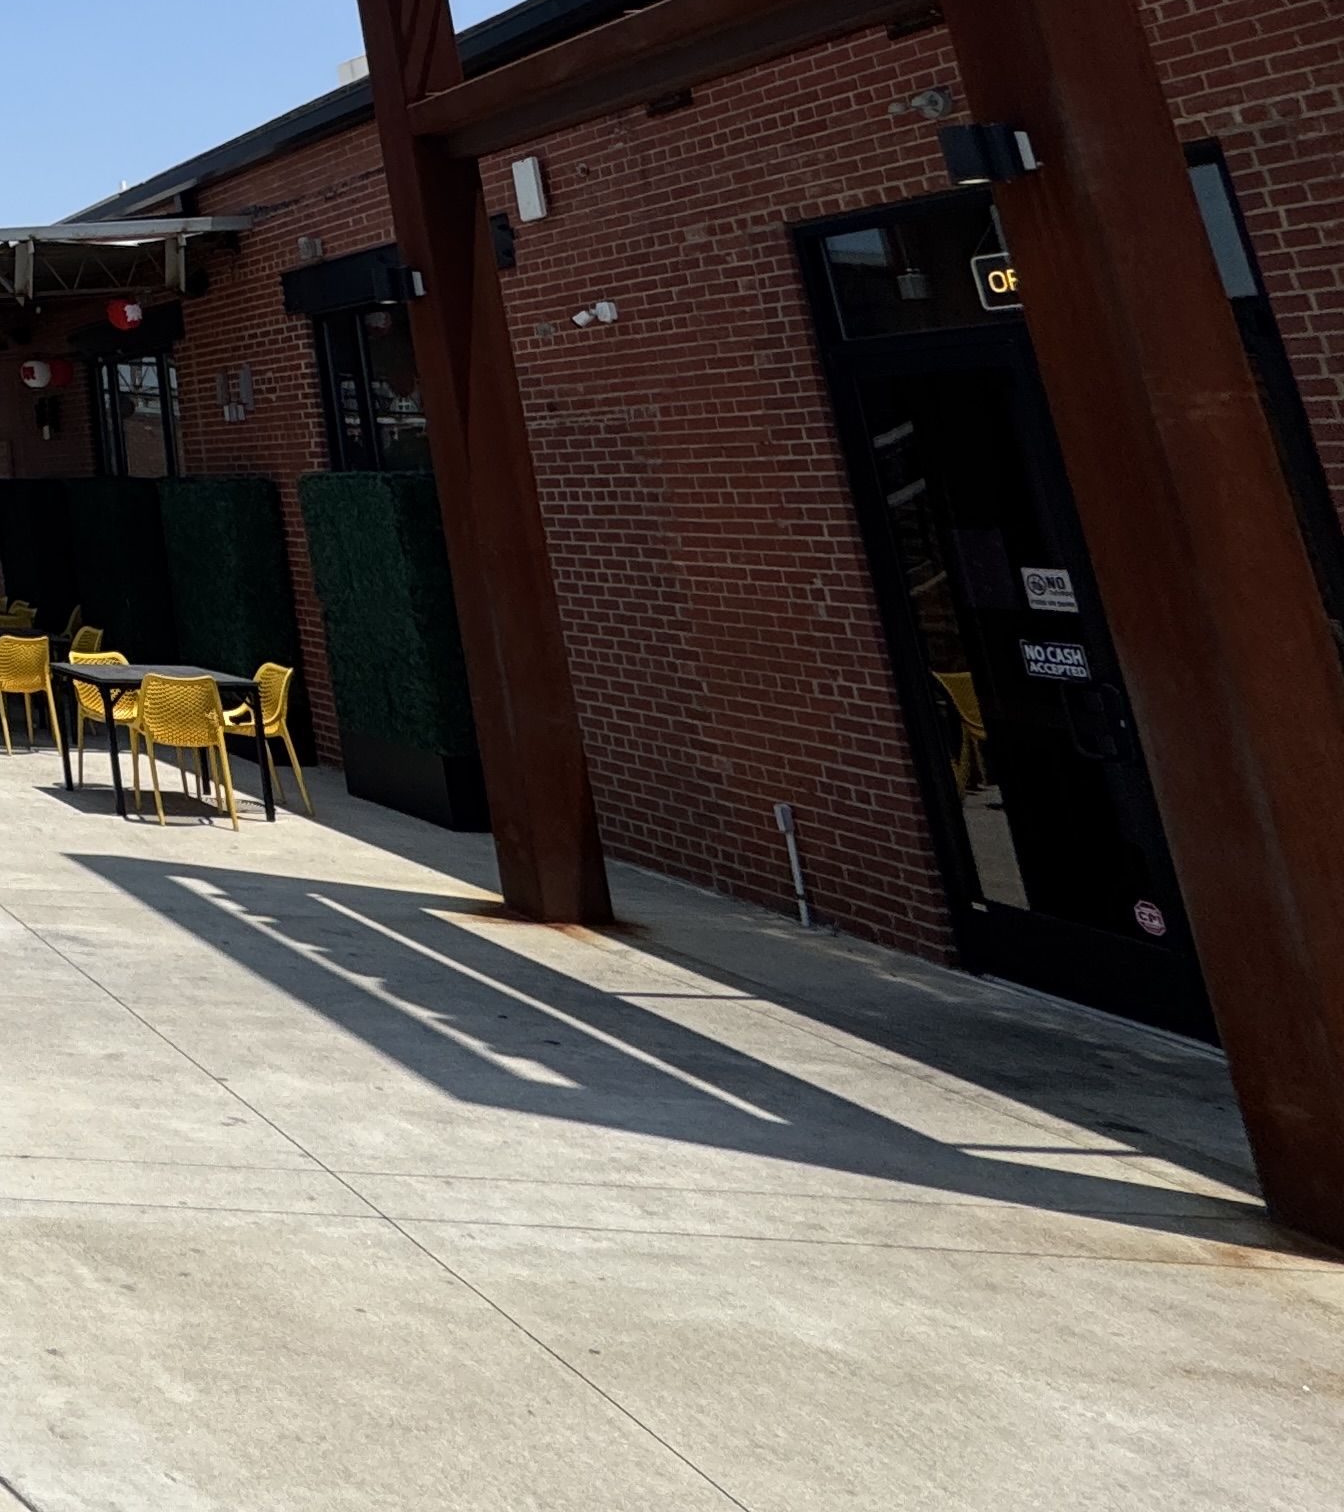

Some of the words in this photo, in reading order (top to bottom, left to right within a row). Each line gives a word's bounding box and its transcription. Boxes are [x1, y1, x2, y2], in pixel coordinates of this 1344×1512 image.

[988, 269, 1018, 293] OP
[1046, 575, 1067, 590] NO
[1024, 644, 1045, 661] NO
[1047, 646, 1084, 665] CASH
[1029, 662, 1088, 678] ACCEPTED
